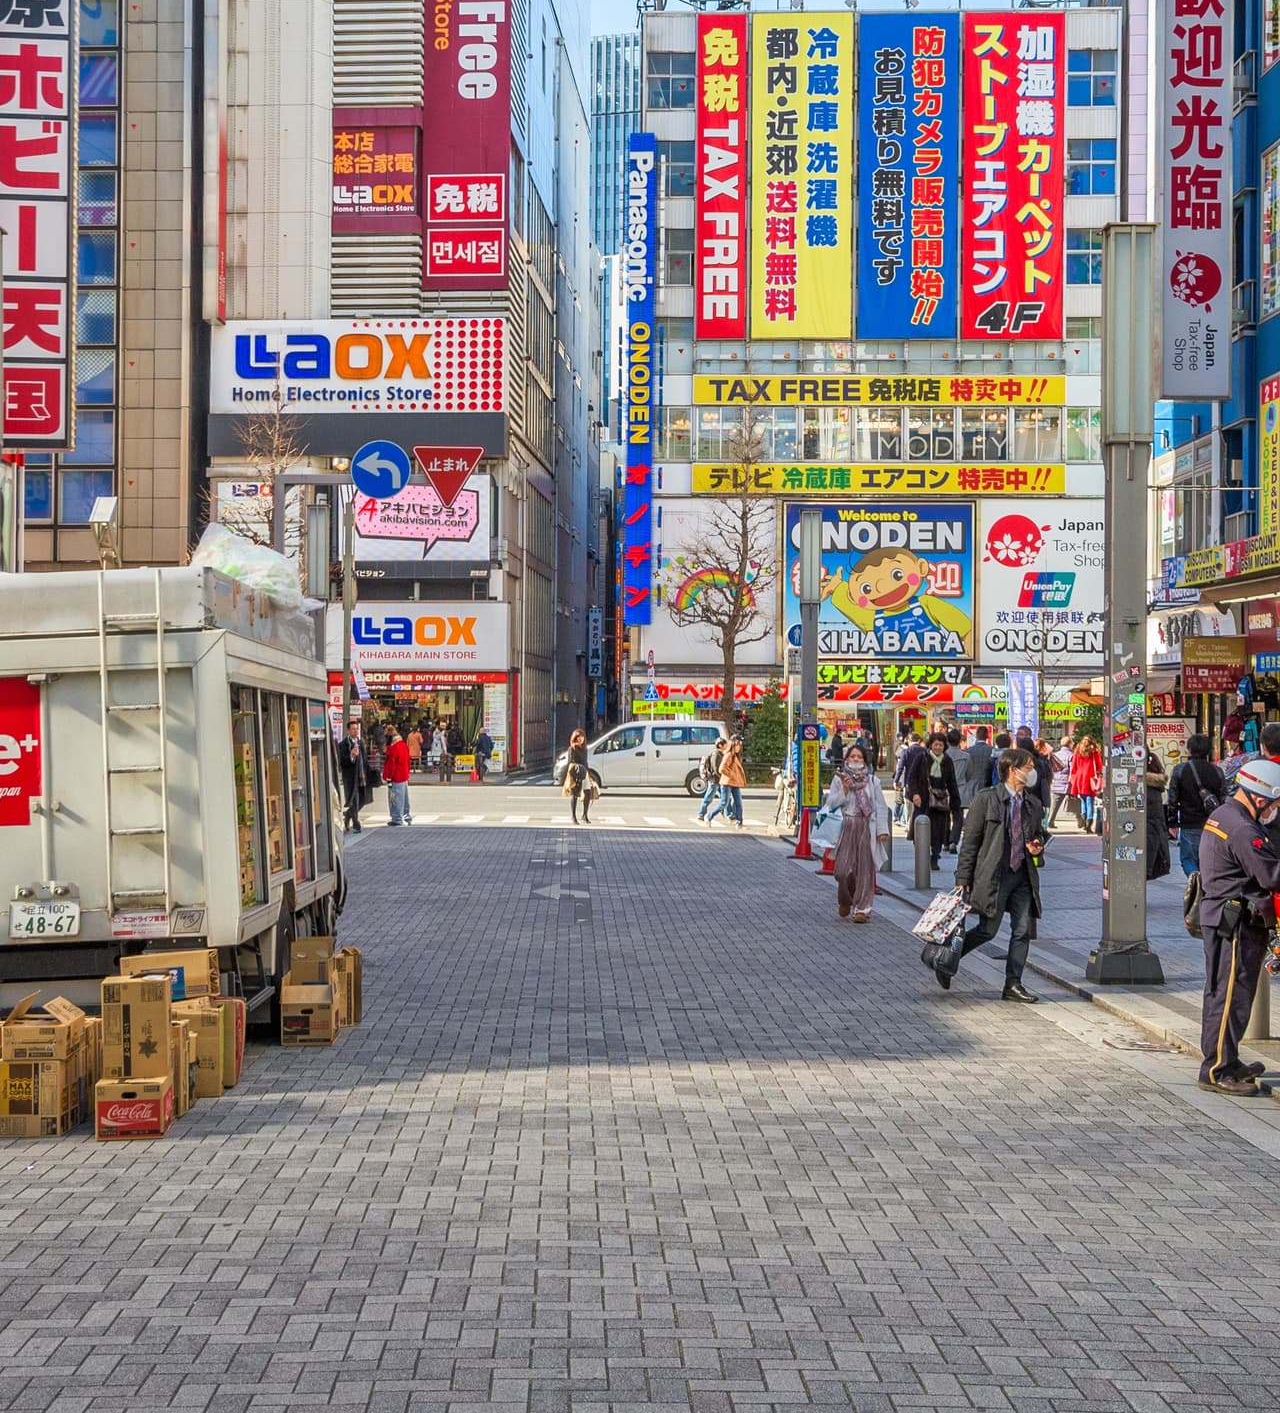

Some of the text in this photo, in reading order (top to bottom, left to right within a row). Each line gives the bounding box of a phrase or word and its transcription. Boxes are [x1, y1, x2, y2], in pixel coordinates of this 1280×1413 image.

[457, 1, 504, 100] Free
[333, 131, 375, 153] 本店
[333, 153, 414, 175] 総合家電
[701, 27, 740, 321] 免税 TAX FREE
[872, 47, 906, 286] お見積り無料です
[433, 183, 498, 214] 免税
[628, 149, 654, 304] Panasonic
[432, 240, 500, 265] 면세점
[973, 300, 1046, 335] 4F
[1173, 338, 1185, 372] Shop
[232, 386, 433, 402] Home Electronics Store
[630, 321, 651, 445] ONODEN
[709, 379, 770, 403] TAX
[780, 379, 861, 403] FREE
[868, 377, 942, 403] 免税店
[427, 457, 470, 473] 止まれ
[708, 467, 776, 490] テレビ
[781, 467, 852, 490] 冷蔵庫
[860, 468, 950, 490] エアコン
[378, 513, 469, 529] akibavision.com
[837, 509, 918, 523] Welcome to
[625, 463, 652, 608] オノデン
[1244, 533, 1277, 554] DISCOUNT
[1186, 549, 1213, 567] DISCOUNT
[1184, 565, 1217, 583] COMPUTERS
[1023, 579, 1073, 593] UnionPay
[985, 629, 1105, 653] ONODEN
[359, 650, 478, 660] KIHABARA MAIN STORE
[24, 915, 75, 934] 48-67
[10, 1082, 32, 1091] MAX
